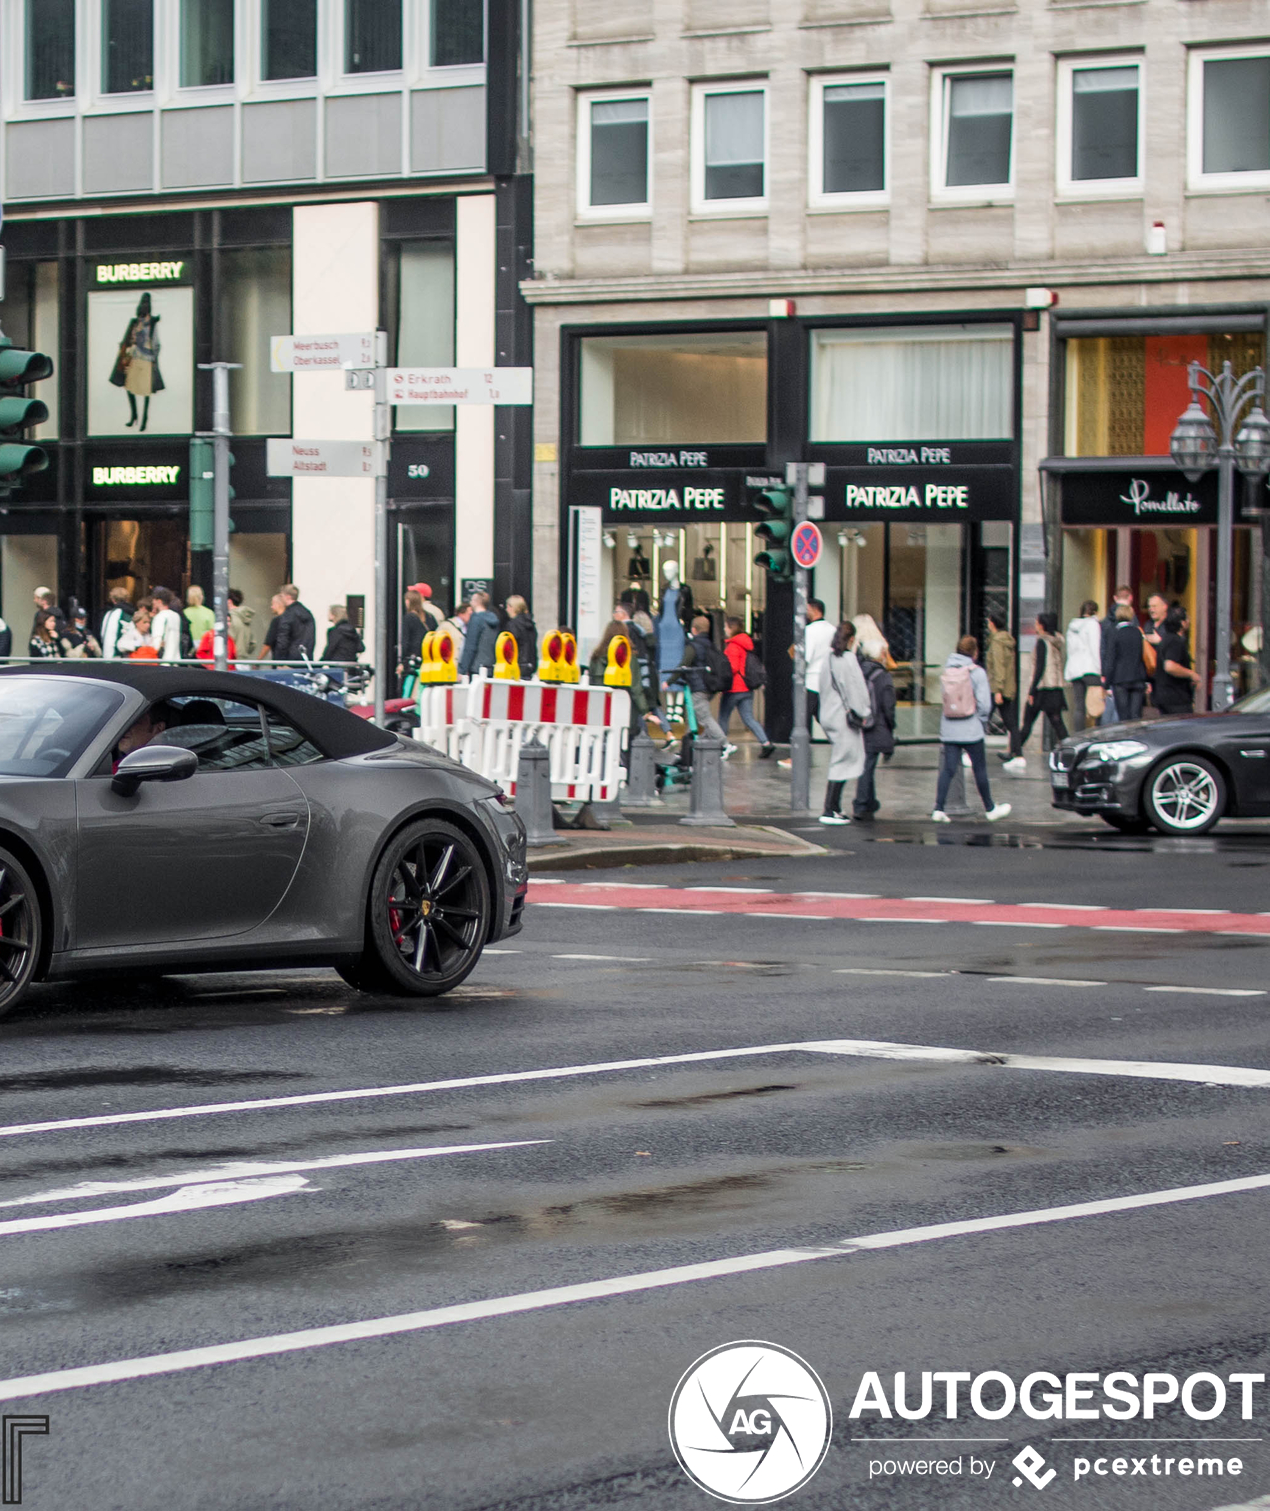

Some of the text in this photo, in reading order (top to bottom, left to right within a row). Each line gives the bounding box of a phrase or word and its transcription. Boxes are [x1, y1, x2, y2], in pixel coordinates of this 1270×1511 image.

[96, 261, 184, 283] BURBERRY
[293, 340, 339, 351] Meerbusch
[293, 354, 341, 365] Oberkassel
[408, 373, 493, 384] Erkrath 12
[408, 388, 469, 400] Hauptbahnhof
[292, 445, 320, 456] Neuss
[867, 447, 951, 464] PATRIZIA PEPE
[292, 460, 327, 471] Altstadt
[630, 451, 708, 467] PATRIZIA PEPE
[92, 466, 180, 486] BURBERRY
[407, 464, 430, 479] 50
[610, 487, 725, 509] PATRIZIA PEPE
[846, 485, 969, 508] PATRIZIA PEPE
[1119, 478, 1201, 515] Pomellato
